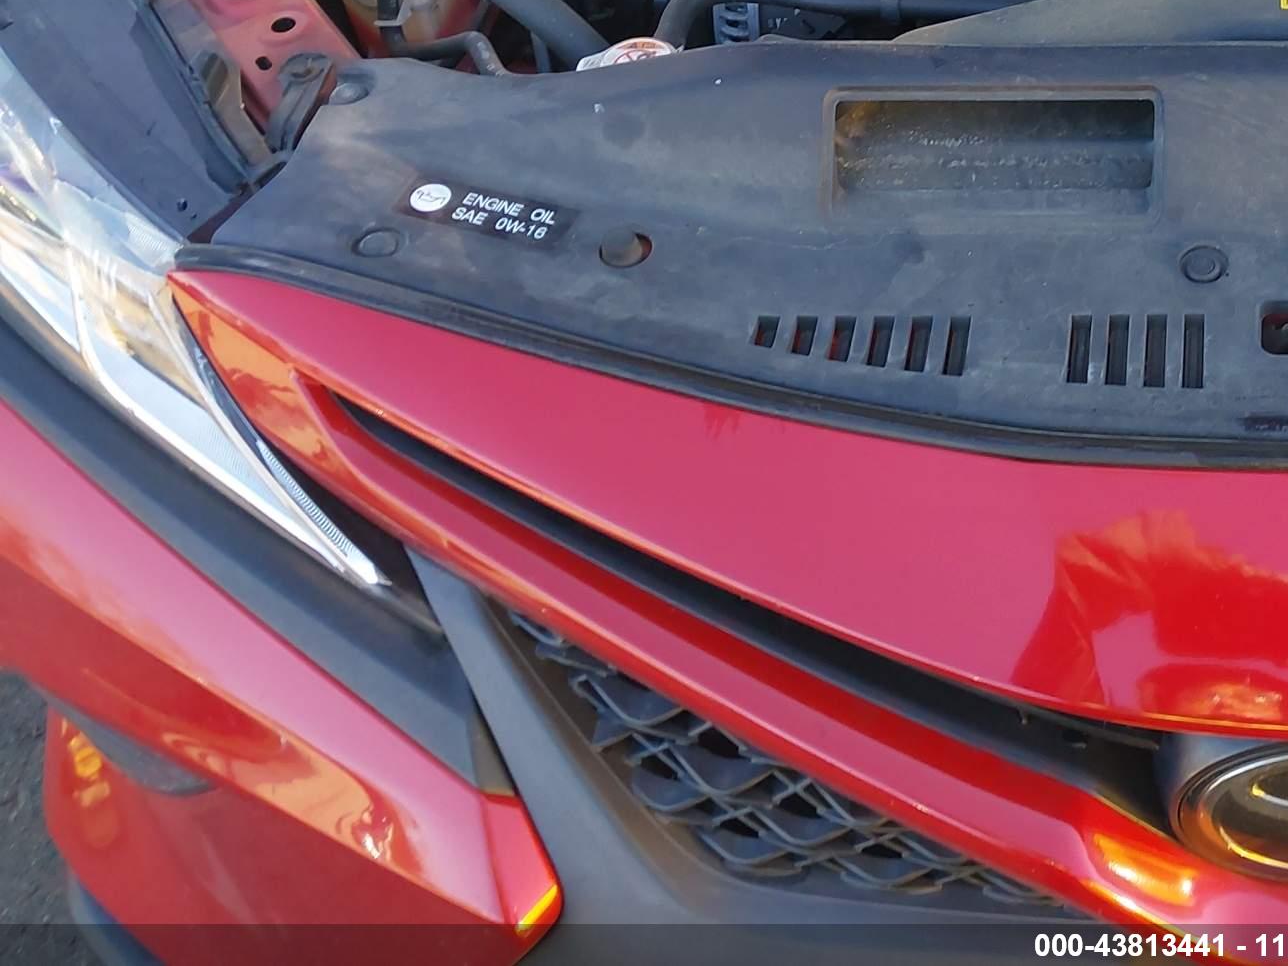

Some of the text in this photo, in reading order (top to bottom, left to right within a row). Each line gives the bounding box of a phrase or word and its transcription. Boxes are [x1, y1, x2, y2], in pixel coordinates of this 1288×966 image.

[451, 207, 548, 240] SAE 0W-16
[462, 192, 556, 225] ENGINE OIL
